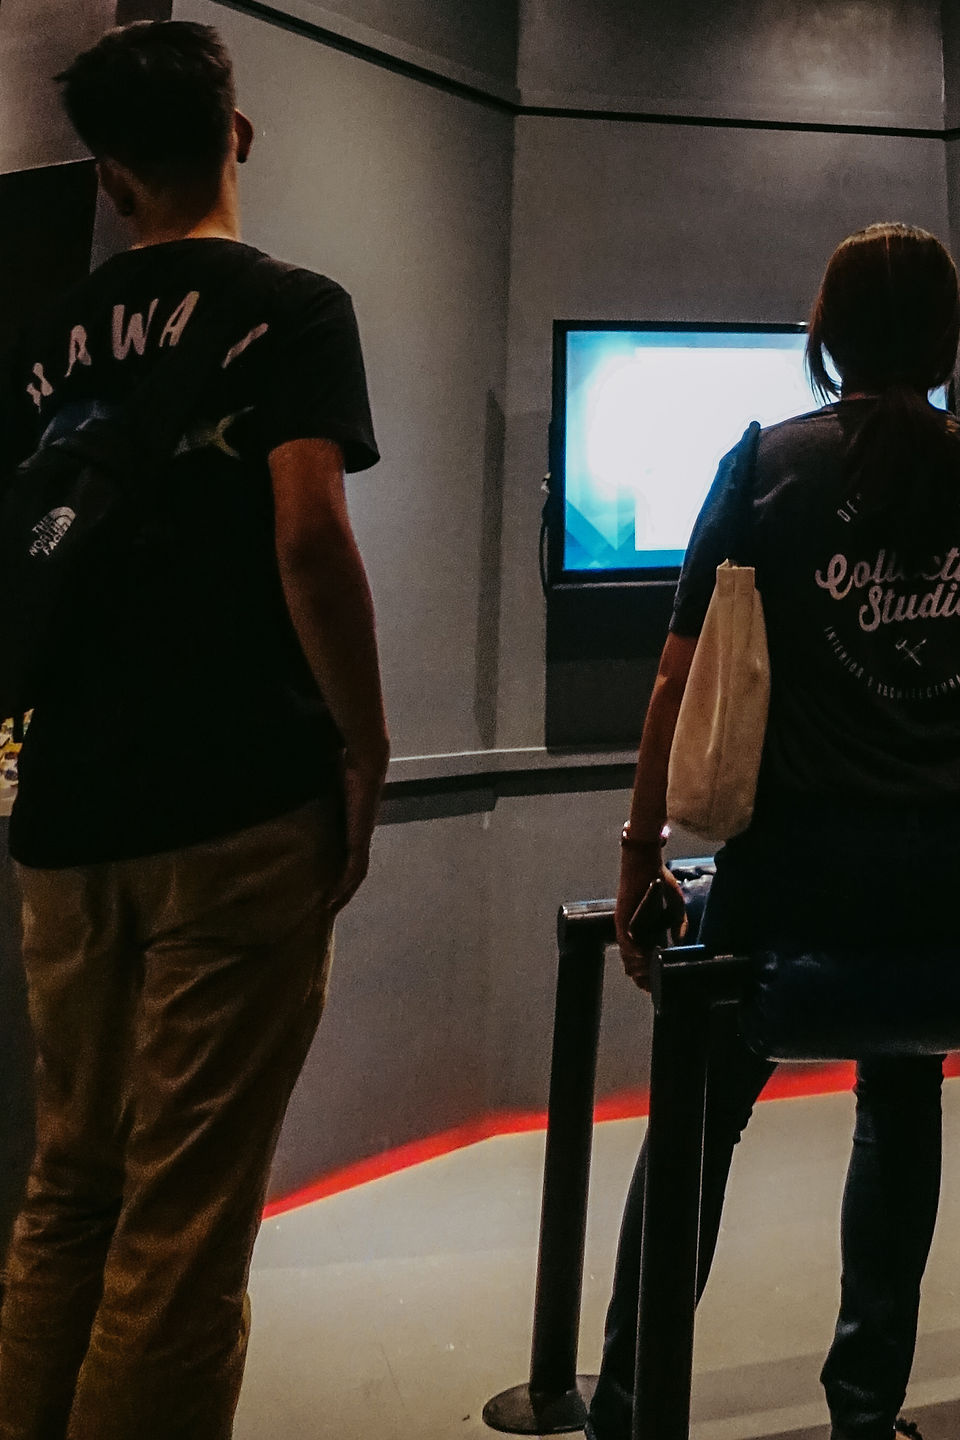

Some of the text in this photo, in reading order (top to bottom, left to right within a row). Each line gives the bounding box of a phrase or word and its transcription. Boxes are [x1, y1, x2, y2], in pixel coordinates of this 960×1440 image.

[28, 520, 62, 557] NORTH
[32, 514, 52, 534] THE
[42, 523, 69, 556] FACE
